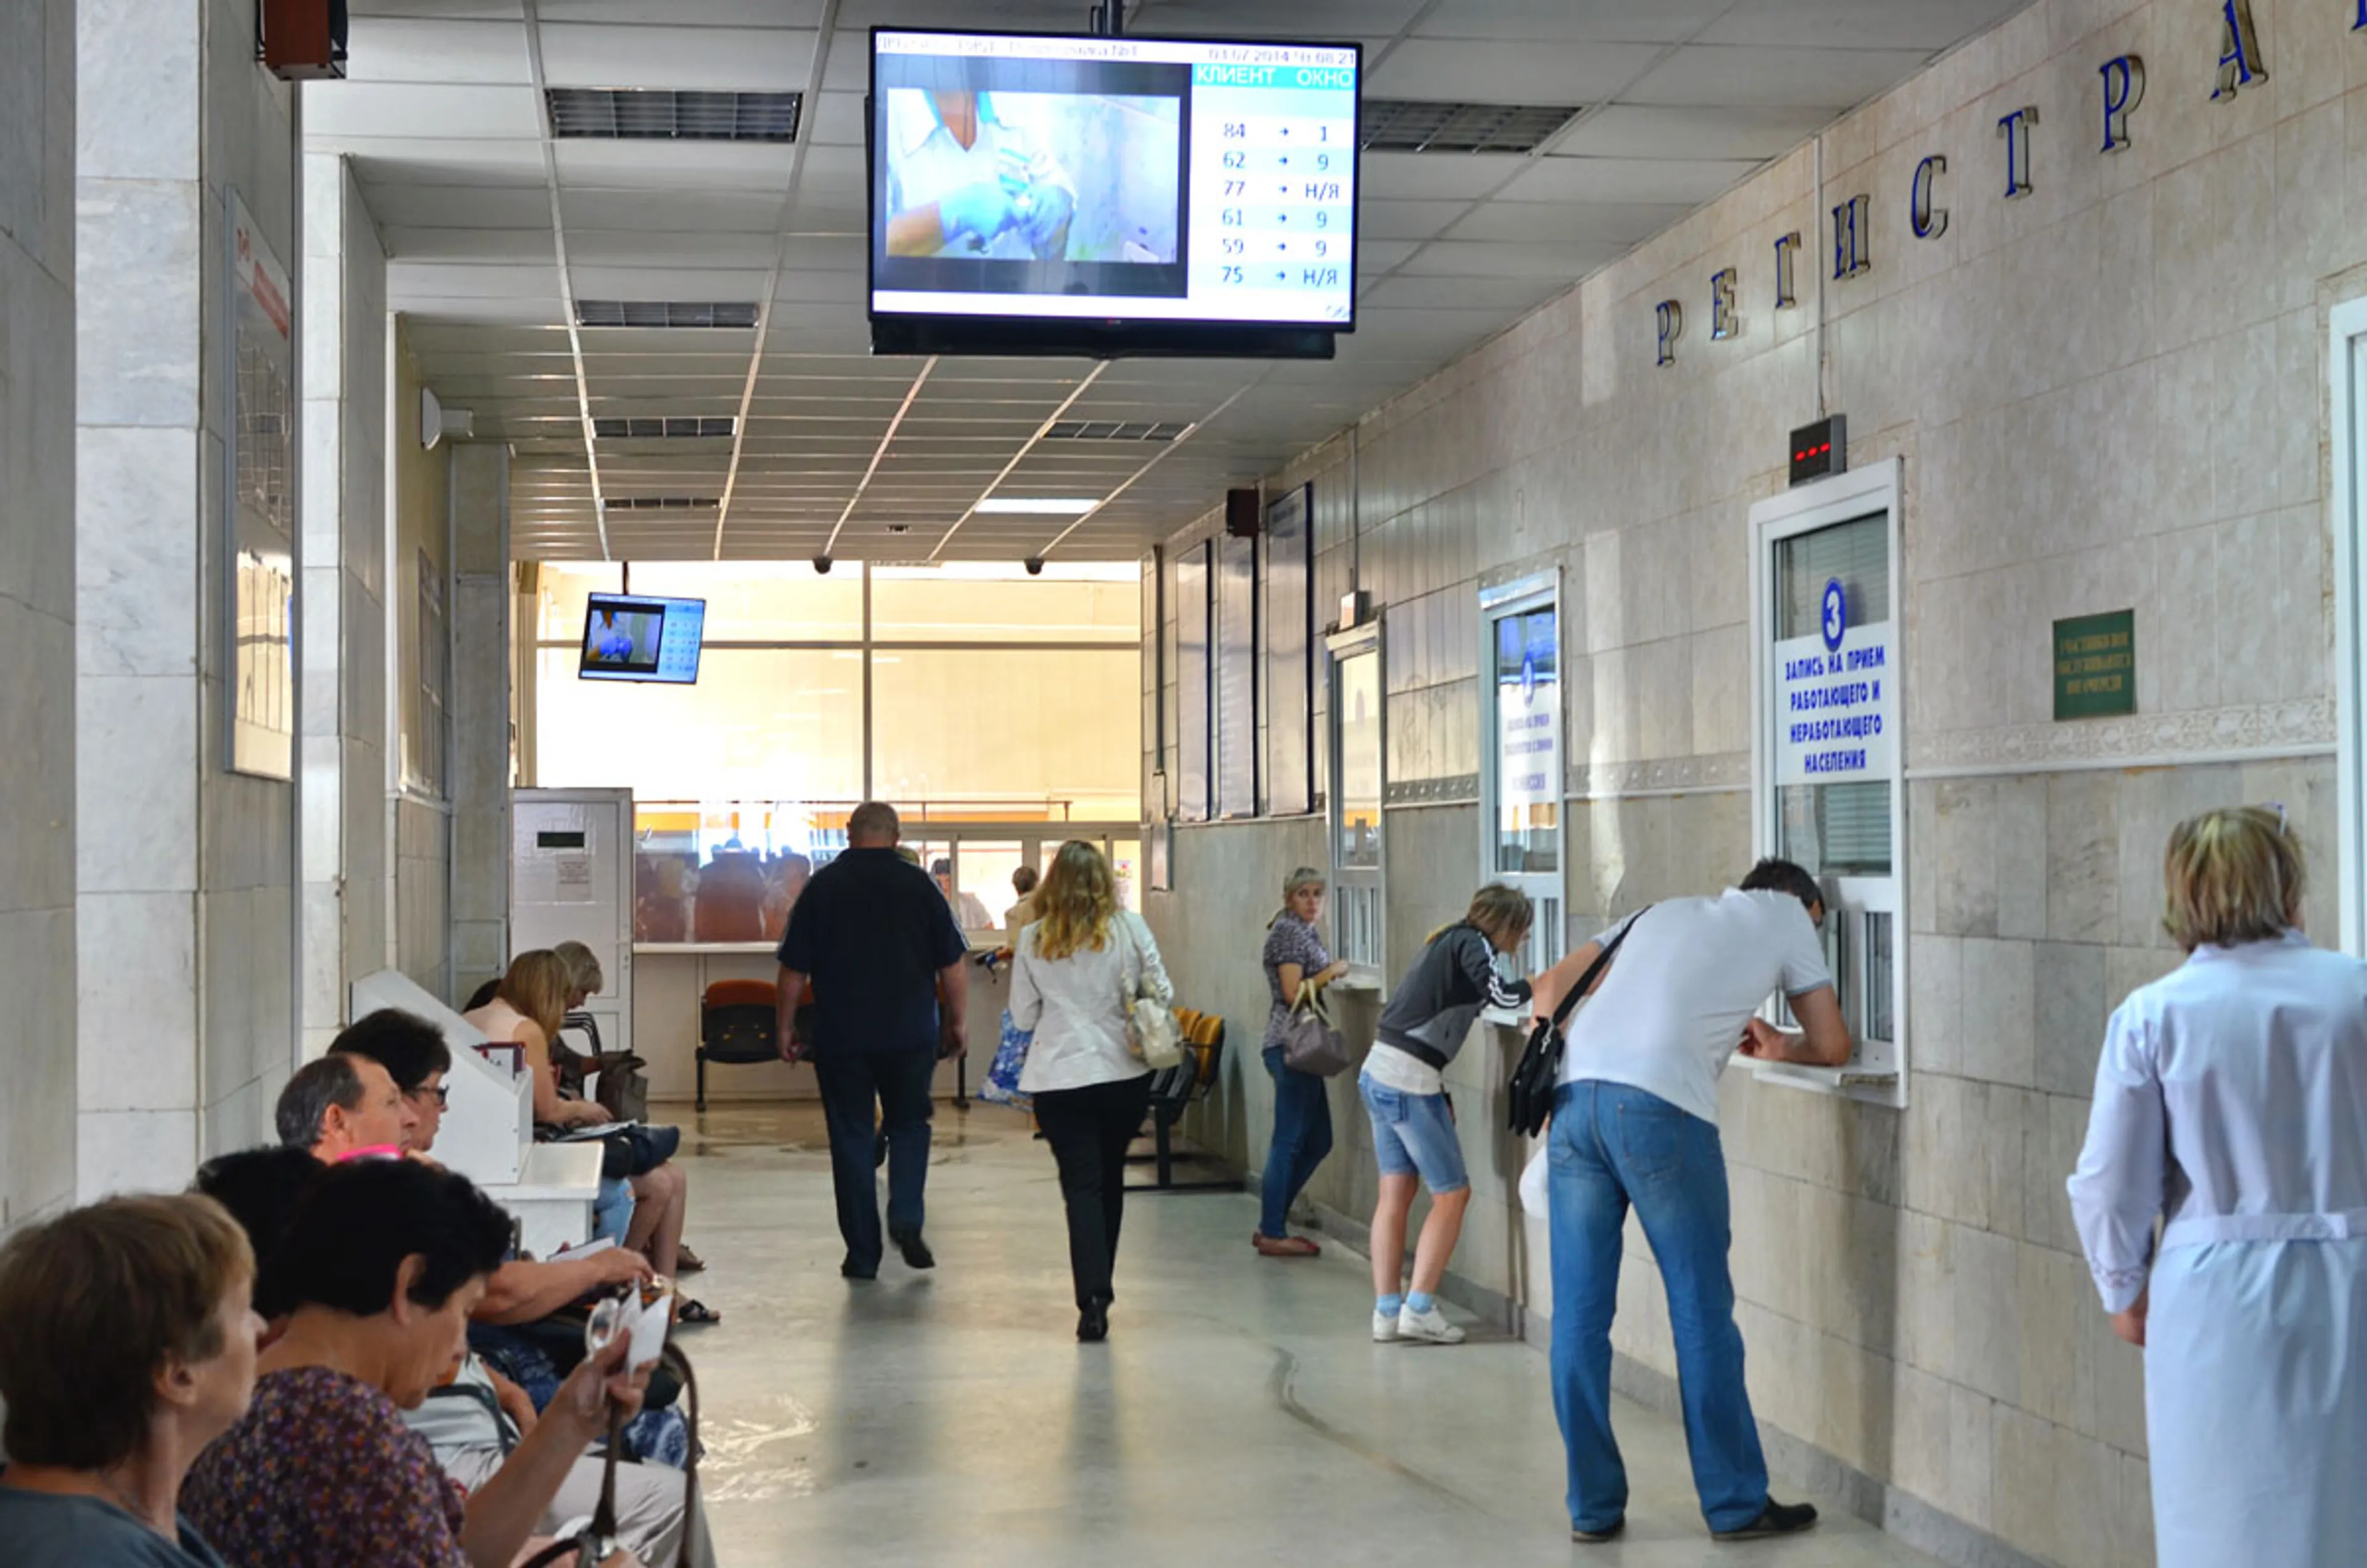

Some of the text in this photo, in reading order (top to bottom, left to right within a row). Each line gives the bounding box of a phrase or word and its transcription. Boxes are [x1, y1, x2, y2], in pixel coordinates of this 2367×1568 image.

[1196, 65, 1354, 88] КЛИЕНТ ОКНО
[1224, 123, 1327, 142] 84 1
[1223, 151, 1329, 171] 62 9
[1224, 180, 1339, 201] 77 Н/Я
[1656, 0, 2367, 367] РЕГИСТРА
[1222, 208, 1328, 228] 61 9
[1222, 238, 1327, 257] 59 9
[1221, 266, 1337, 288] 75 Н/Я
[1826, 590, 1841, 640] 3
[1785, 645, 1886, 681] ЗАПИСЬ НА ПРИЕМ
[1790, 679, 1881, 711] РАБОТАЮЩЕГО И
[1790, 714, 1883, 743] НЕРАБОТАЮЩЕГО
[1804, 748, 1866, 774] НАСЕЛЕНИЯ
